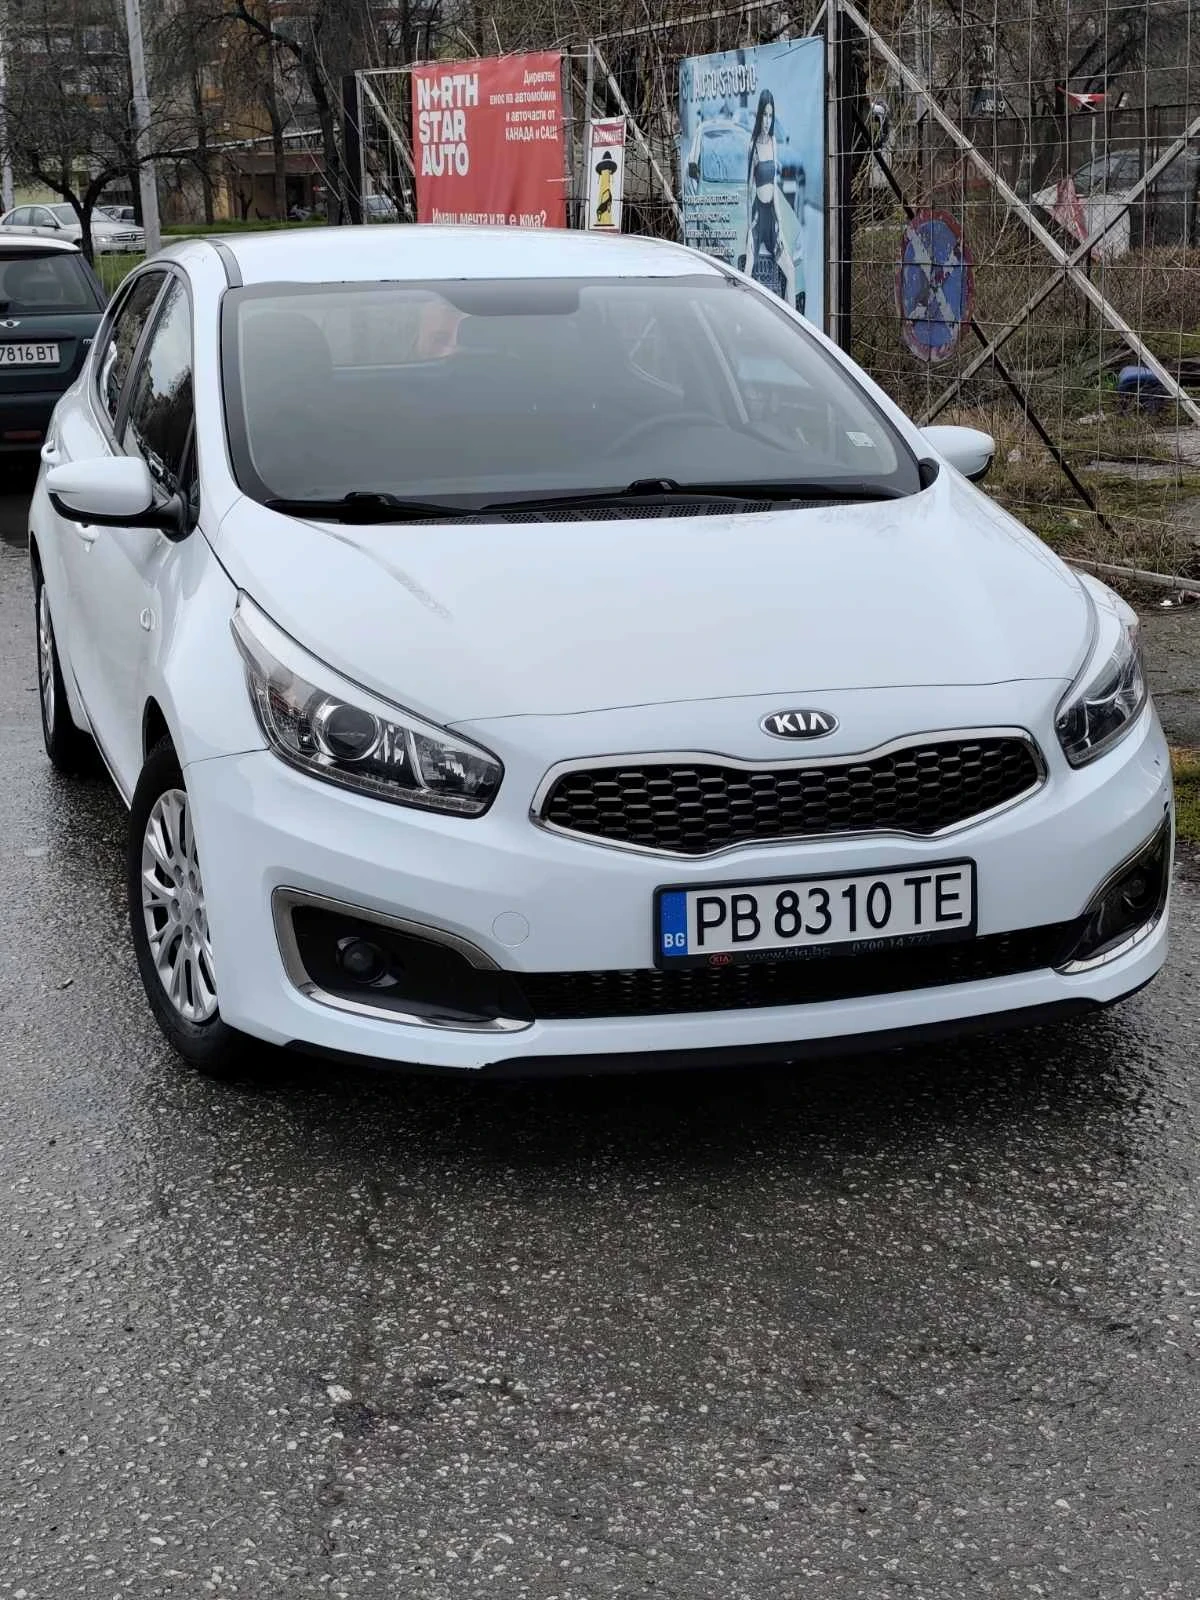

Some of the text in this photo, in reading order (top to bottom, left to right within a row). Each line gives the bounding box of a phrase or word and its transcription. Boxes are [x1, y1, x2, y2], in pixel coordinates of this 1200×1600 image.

[523, 70, 555, 85] Директен
[720, 64, 757, 97] STUDIO
[515, 87, 556, 104] автомобили
[511, 110, 546, 122] авточасти
[547, 110, 556, 120] от
[419, 109, 467, 144] STAR
[505, 126, 534, 142] КАНАДА
[540, 125, 559, 141] САЩ
[421, 142, 470, 177] AUTO
[432, 207, 457, 225] Имаш
[509, 214, 517, 226] е
[520, 209, 548, 230] кола?
[773, 712, 830, 733] KIA
[696, 872, 963, 946] PB 8310 TE
[664, 933, 686, 948] BG
[852, 940, 884, 952] 0700
[890, 937, 904, 949] 14
